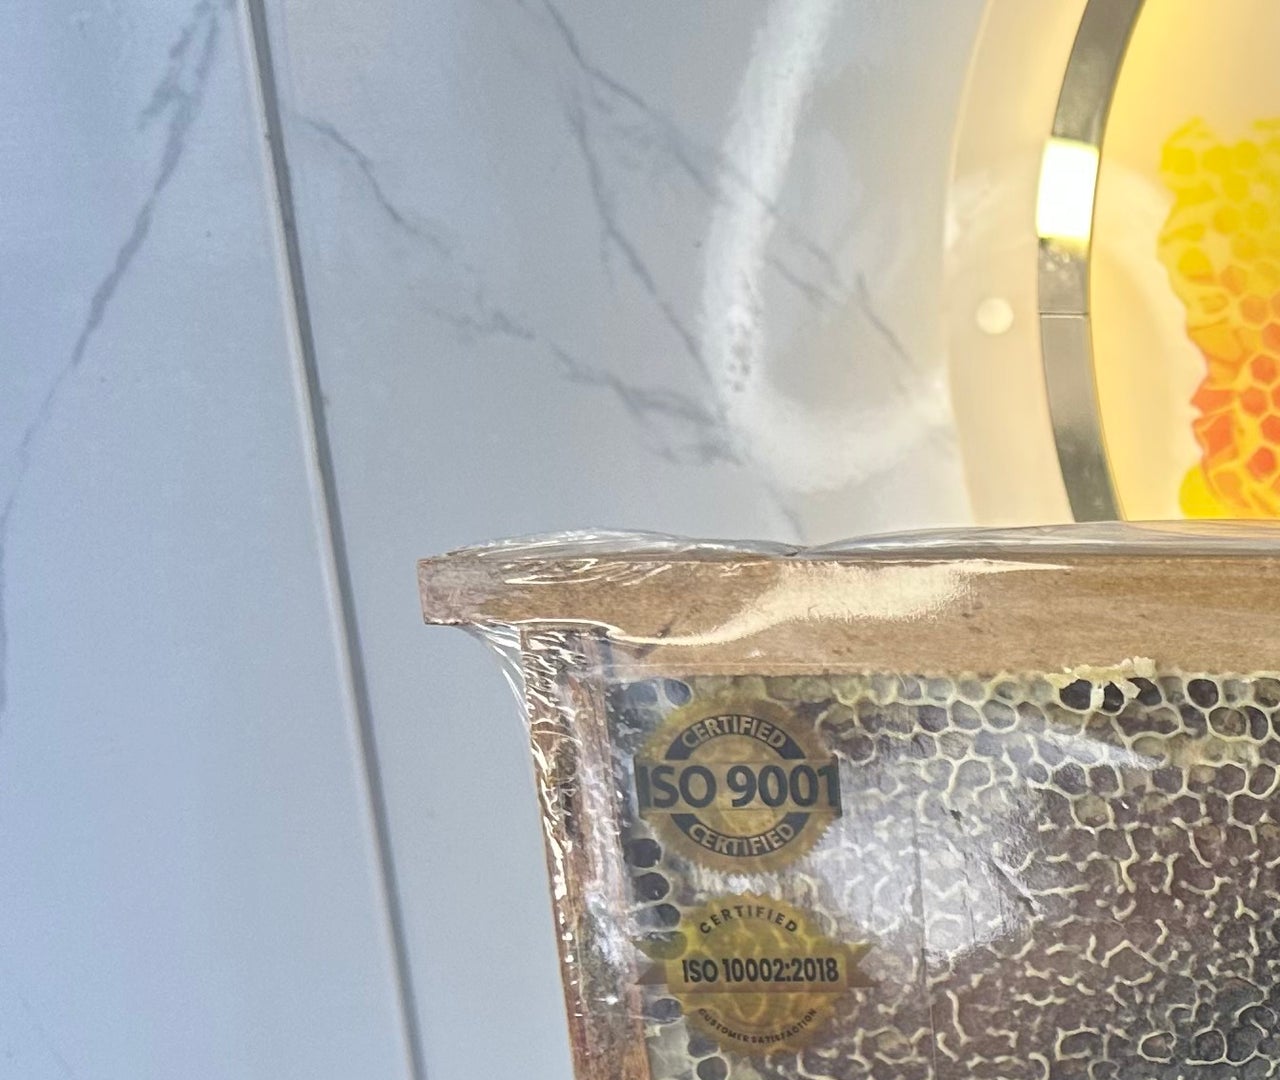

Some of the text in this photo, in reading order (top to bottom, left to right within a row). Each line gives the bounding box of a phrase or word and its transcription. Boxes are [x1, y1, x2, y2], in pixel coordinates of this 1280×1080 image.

[681, 715, 787, 748] CERTIFIED
[637, 764, 839, 809] ISO 9001
[689, 823, 795, 856] CERTIFIED
[700, 904, 798, 934] CERTIFIED
[682, 957, 839, 983] ISO 10002:2018
[699, 1008, 817, 1044] CUSTOMER SATISFACTION
